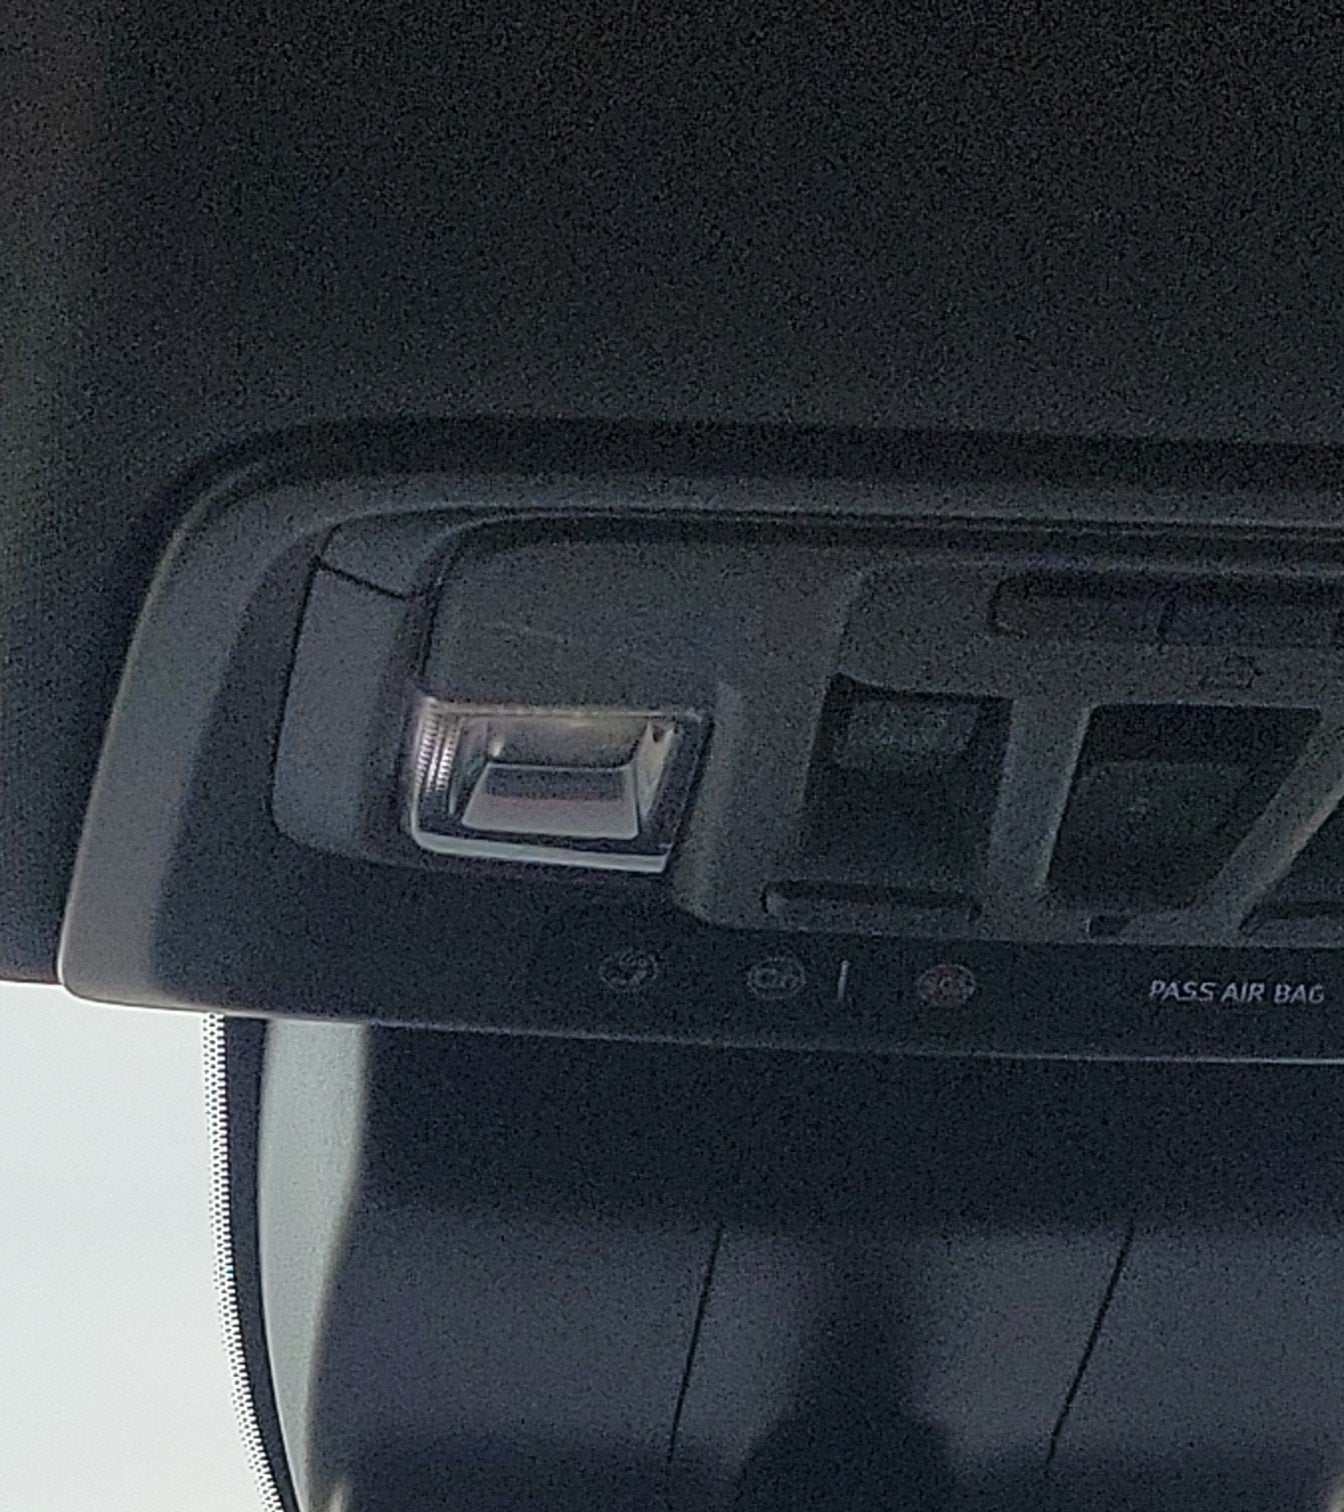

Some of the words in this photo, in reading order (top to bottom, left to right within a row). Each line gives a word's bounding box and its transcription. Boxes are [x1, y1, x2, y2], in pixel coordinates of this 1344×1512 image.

[1147, 980, 1217, 1003] PASS
[1220, 982, 1266, 1004] AIR
[1273, 983, 1325, 1006] BAG
